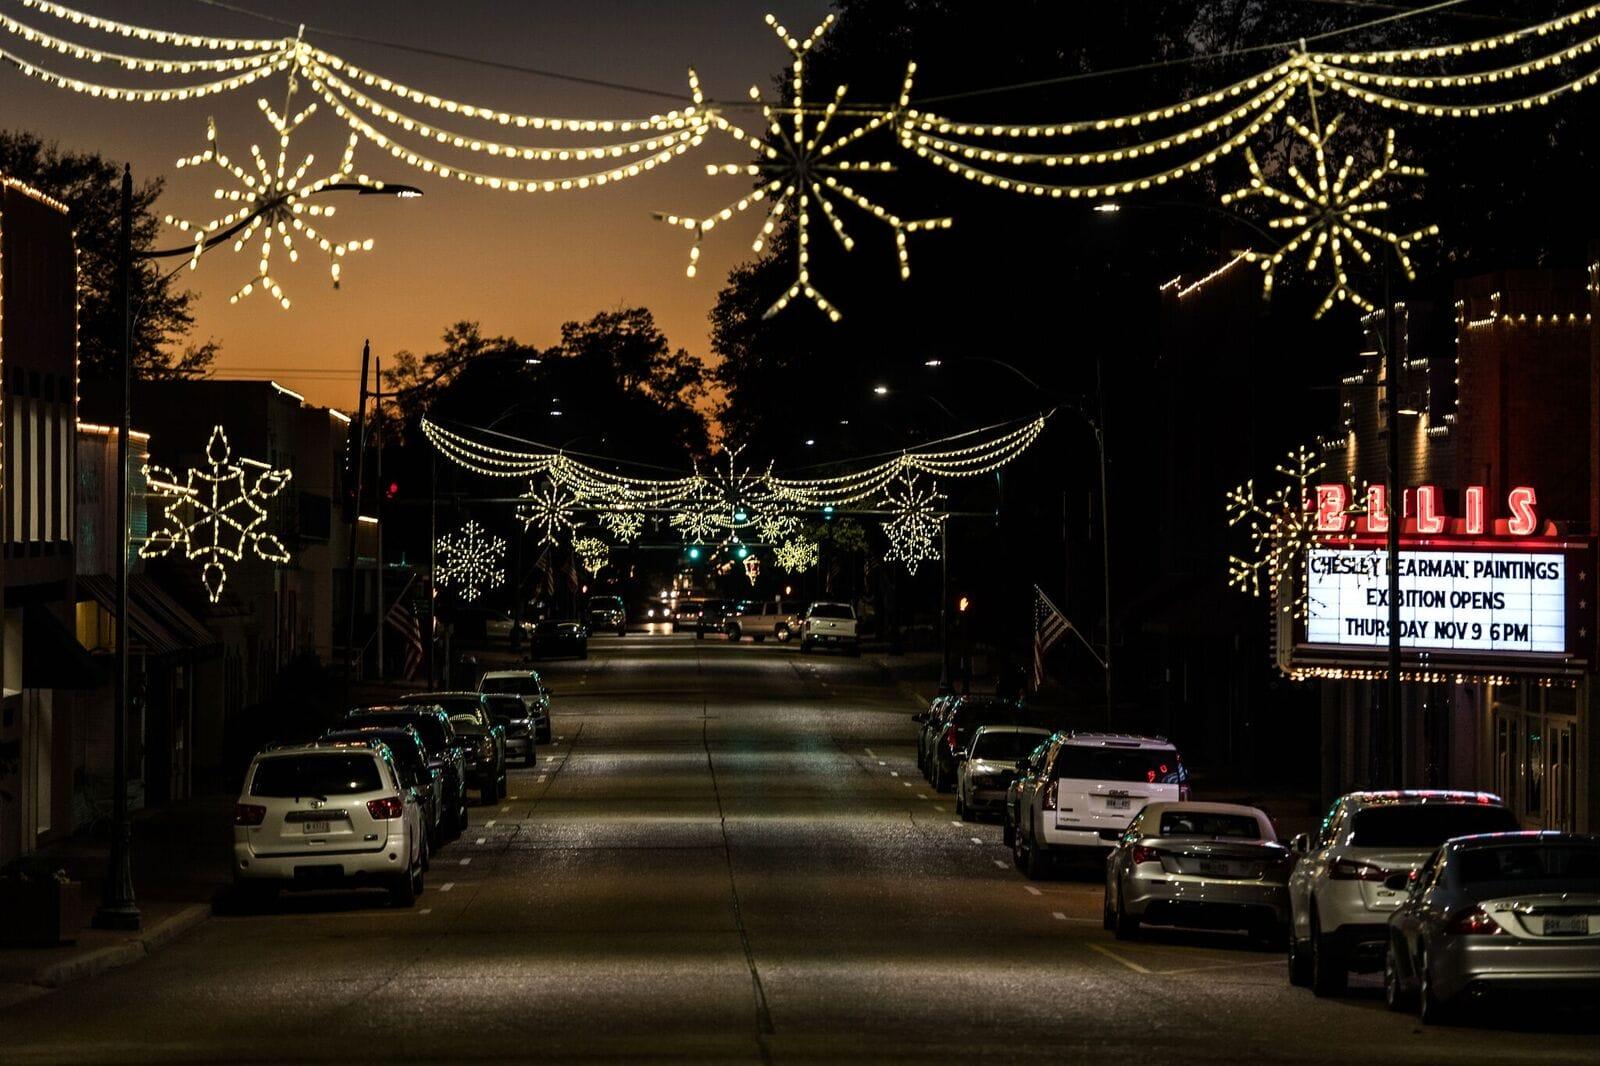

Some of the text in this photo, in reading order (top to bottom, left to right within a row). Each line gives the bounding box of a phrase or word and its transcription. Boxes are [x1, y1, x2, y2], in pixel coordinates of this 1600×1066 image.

[1316, 484, 1538, 536] ELLIS
[1311, 556, 1381, 577] CHESLEY
[1473, 560, 1560, 580] PAINTINGS
[1366, 588, 1505, 610] EXBITION OPENS
[1434, 622, 1468, 640] NOV
[1471, 623, 1482, 640] 9
[1490, 623, 1500, 640] 6
[1503, 624, 1529, 642] PM
